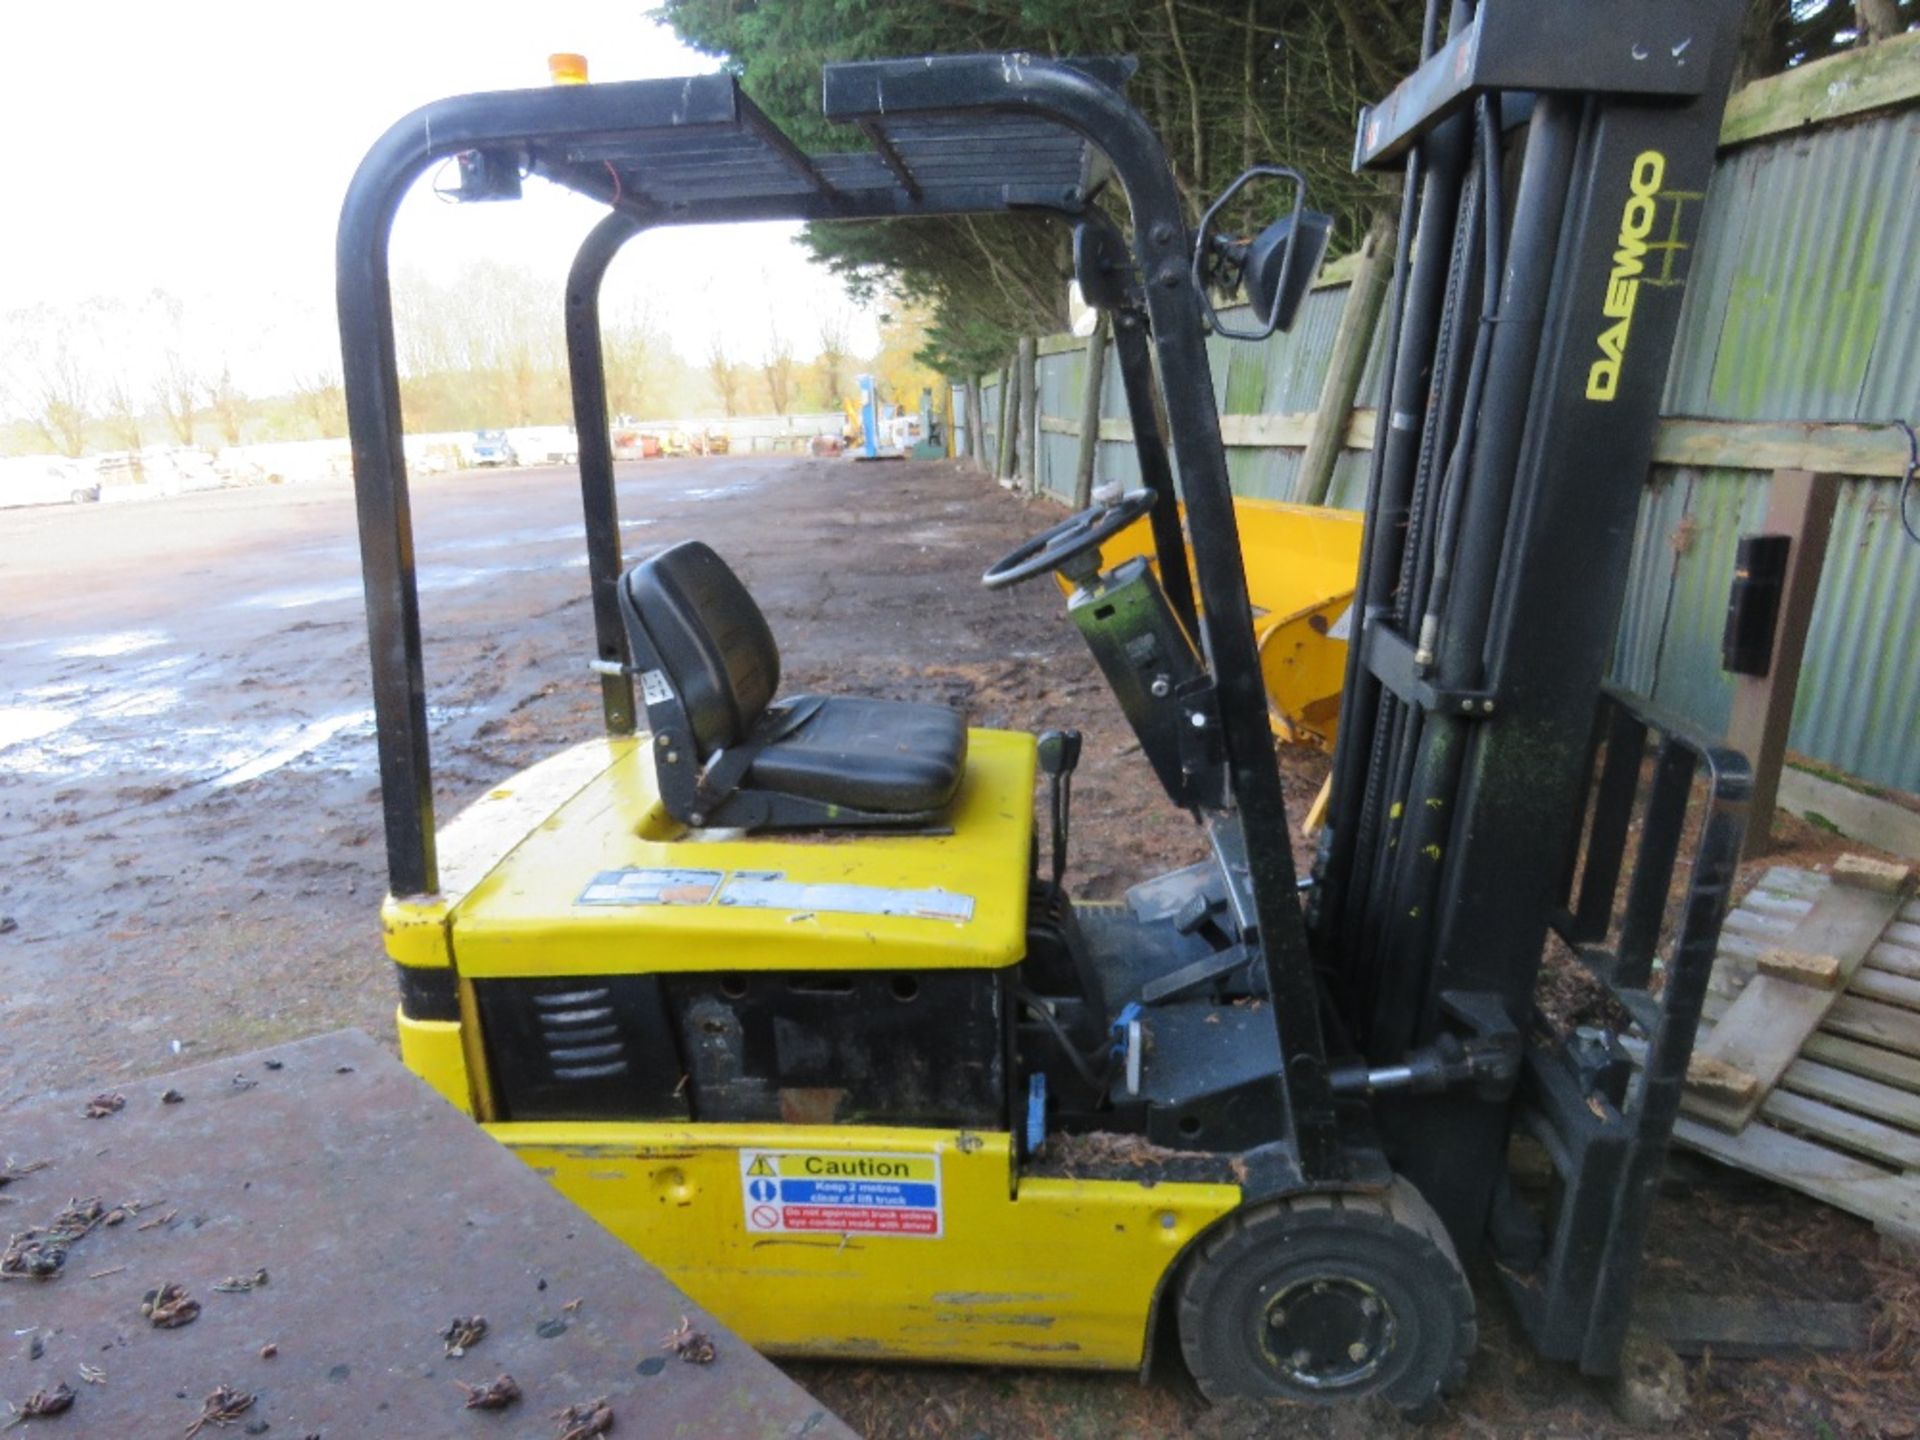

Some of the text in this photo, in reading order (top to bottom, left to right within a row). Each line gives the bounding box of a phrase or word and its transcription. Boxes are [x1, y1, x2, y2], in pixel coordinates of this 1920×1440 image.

[1586, 150, 1666, 401] DAEWOO
[805, 1157, 910, 1177] Caution
[815, 1182, 900, 1194] Keep 2 metres
[810, 1193, 907, 1206] clear of lift truck
[802, 1208, 819, 1217] not
[821, 1209, 869, 1219] approach
[871, 1210, 897, 1219] truck
[900, 1212, 934, 1221] unless
[808, 1218, 847, 1227] contact
[902, 1221, 932, 1231] driver
